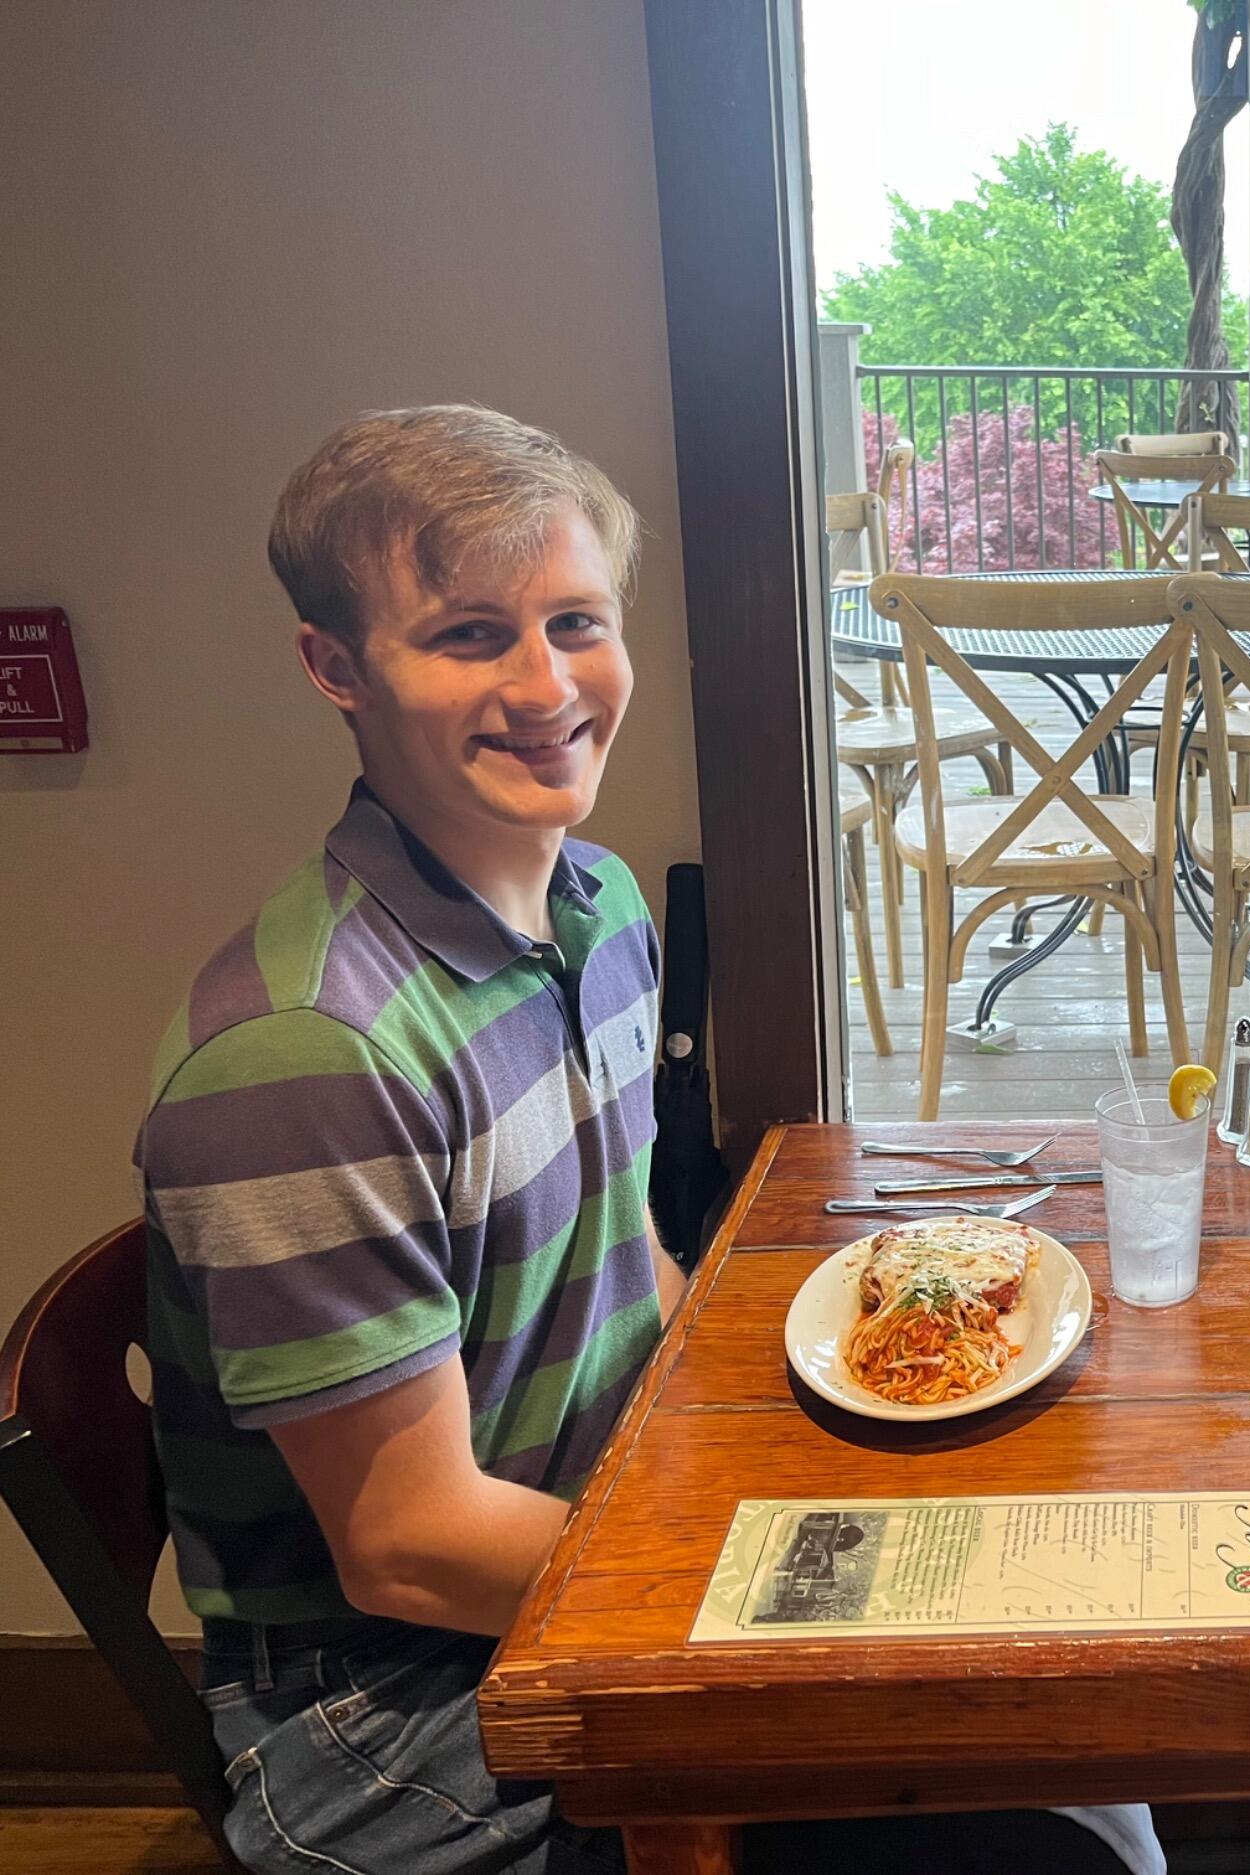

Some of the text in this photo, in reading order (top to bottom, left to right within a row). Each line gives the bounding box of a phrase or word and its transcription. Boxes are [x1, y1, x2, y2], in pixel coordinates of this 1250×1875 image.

[9, 625, 48, 641] ALARM
[0, 667, 22, 680] IFT
[7, 684, 17, 696] &
[0, 701, 35, 713] PULL
